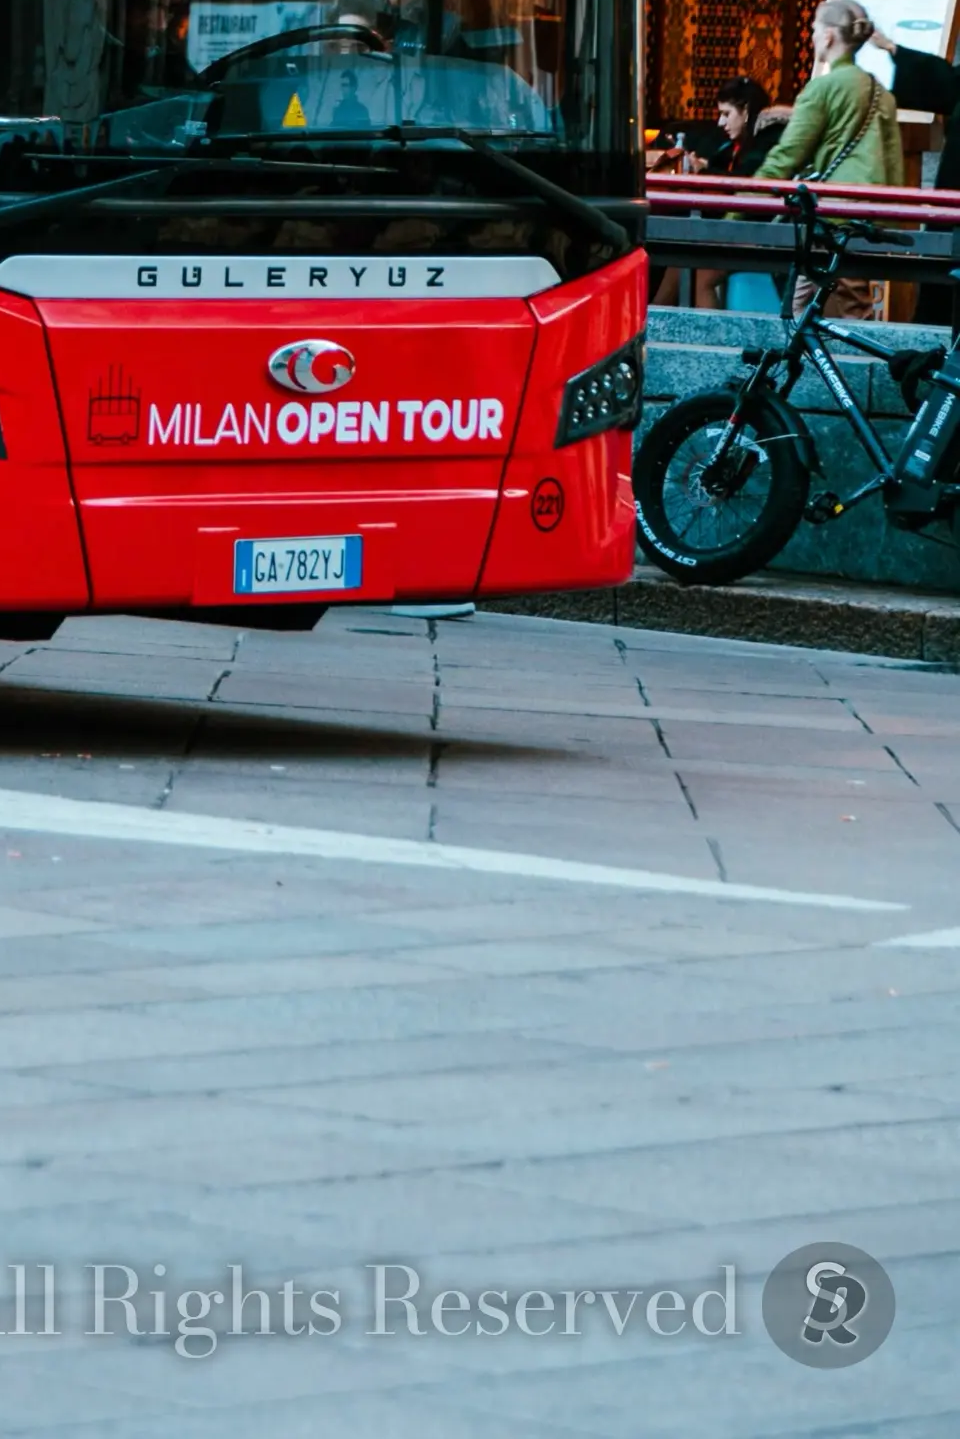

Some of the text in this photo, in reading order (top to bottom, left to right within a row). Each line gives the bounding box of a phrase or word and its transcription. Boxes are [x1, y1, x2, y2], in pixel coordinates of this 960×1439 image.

[197, 14, 258, 36] RESTAURANT
[813, 347, 855, 409] SAMEBIKE
[147, 397, 505, 446] MILAN OPEN TOUR
